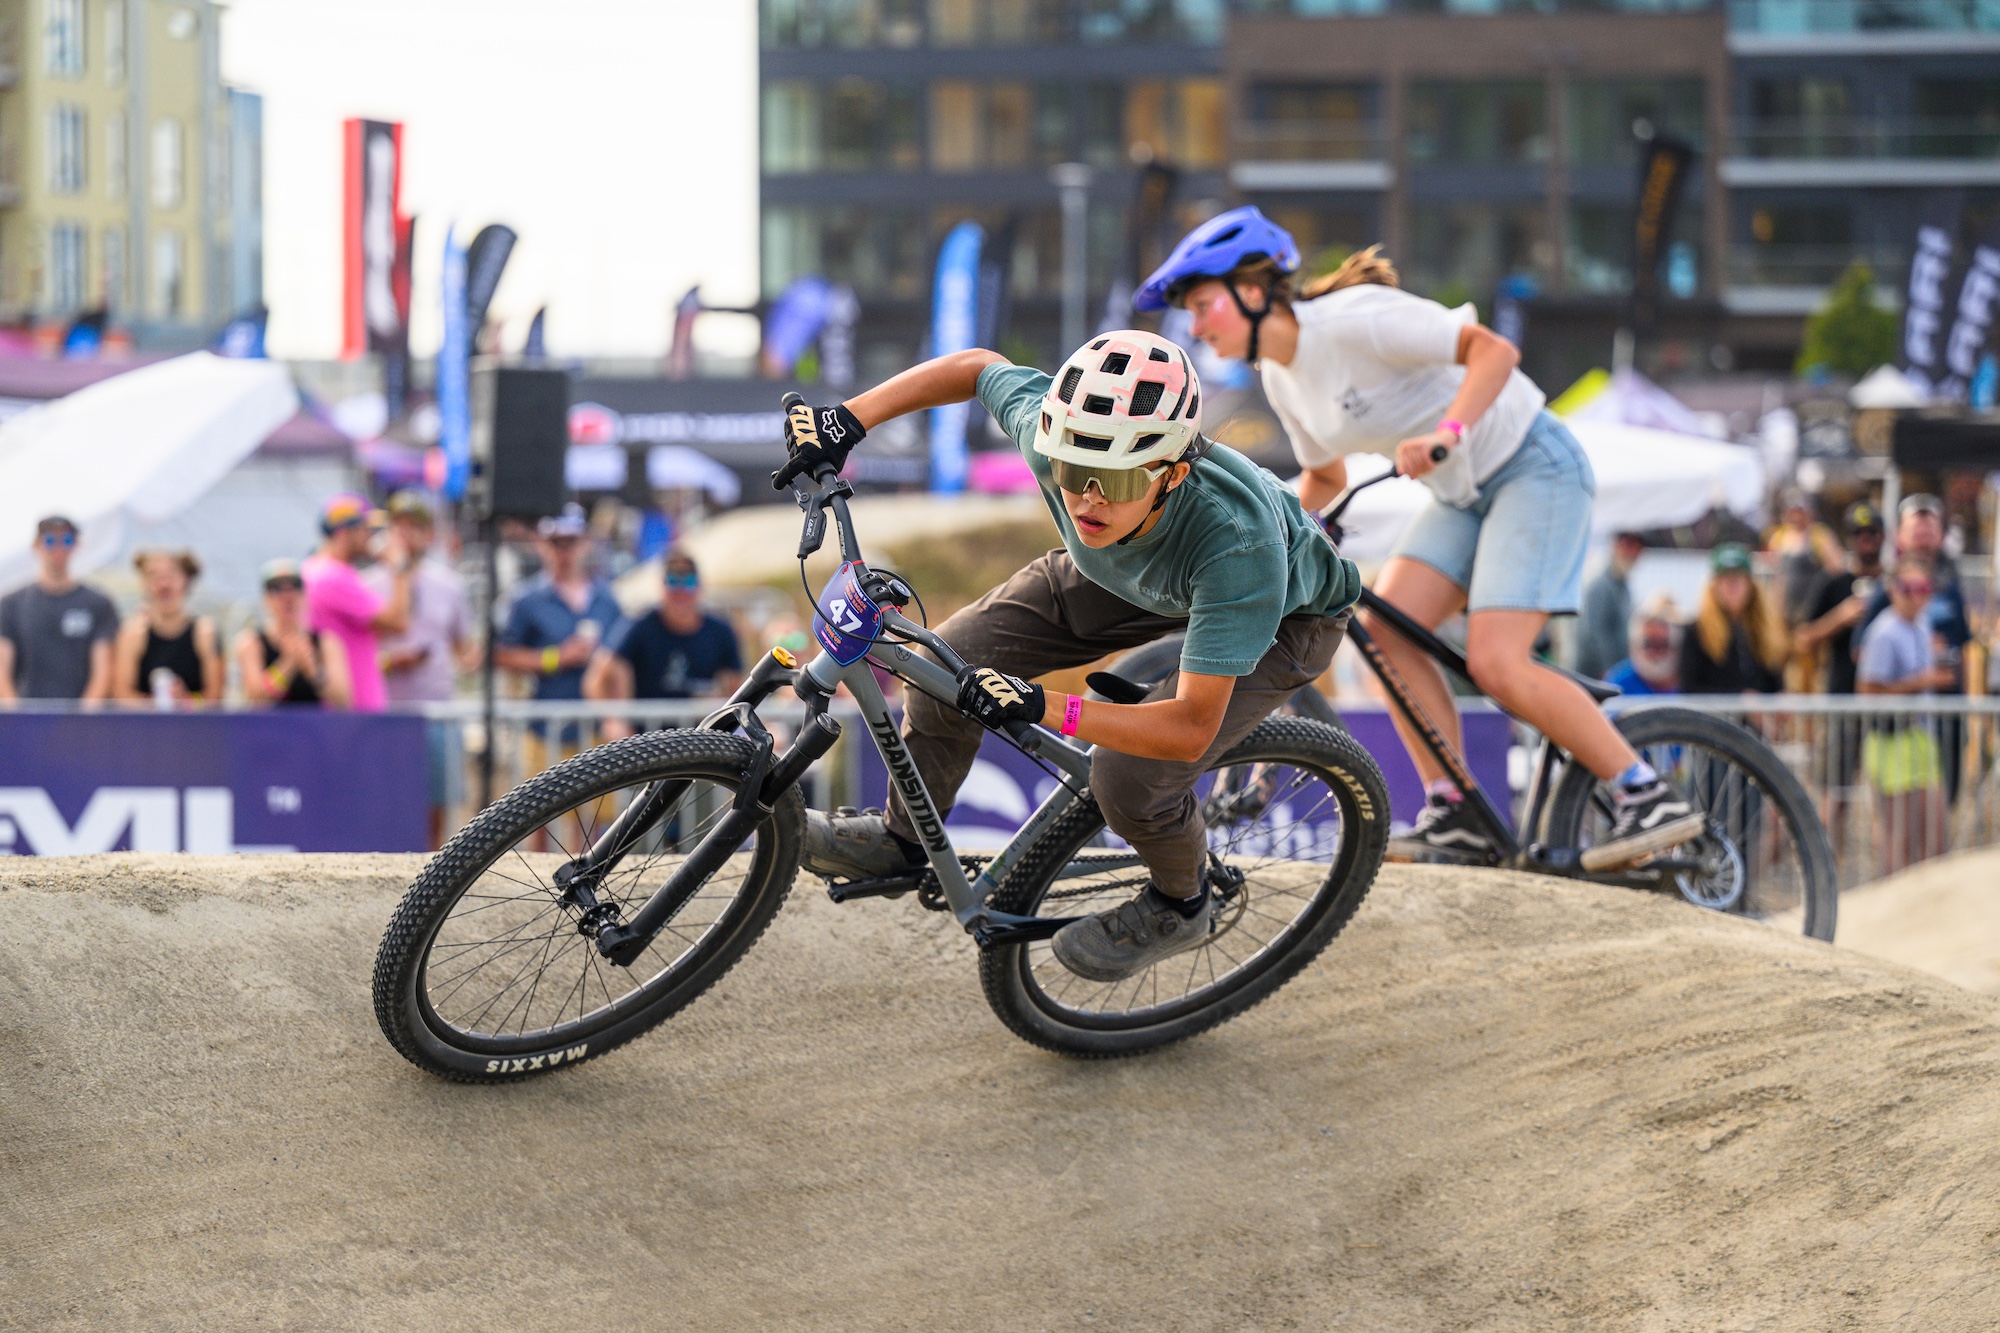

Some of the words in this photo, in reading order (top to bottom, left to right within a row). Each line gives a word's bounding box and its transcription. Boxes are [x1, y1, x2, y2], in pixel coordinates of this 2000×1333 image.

[789, 405, 822, 449] FOX
[829, 599, 863, 633] 47
[974, 667, 1025, 708] FOX
[872, 711, 950, 853] TRANSITION
[1326, 765, 1376, 821] MAXXIS
[0, 785, 299, 855] VIL
[485, 1043, 588, 1073] MAXXIS
